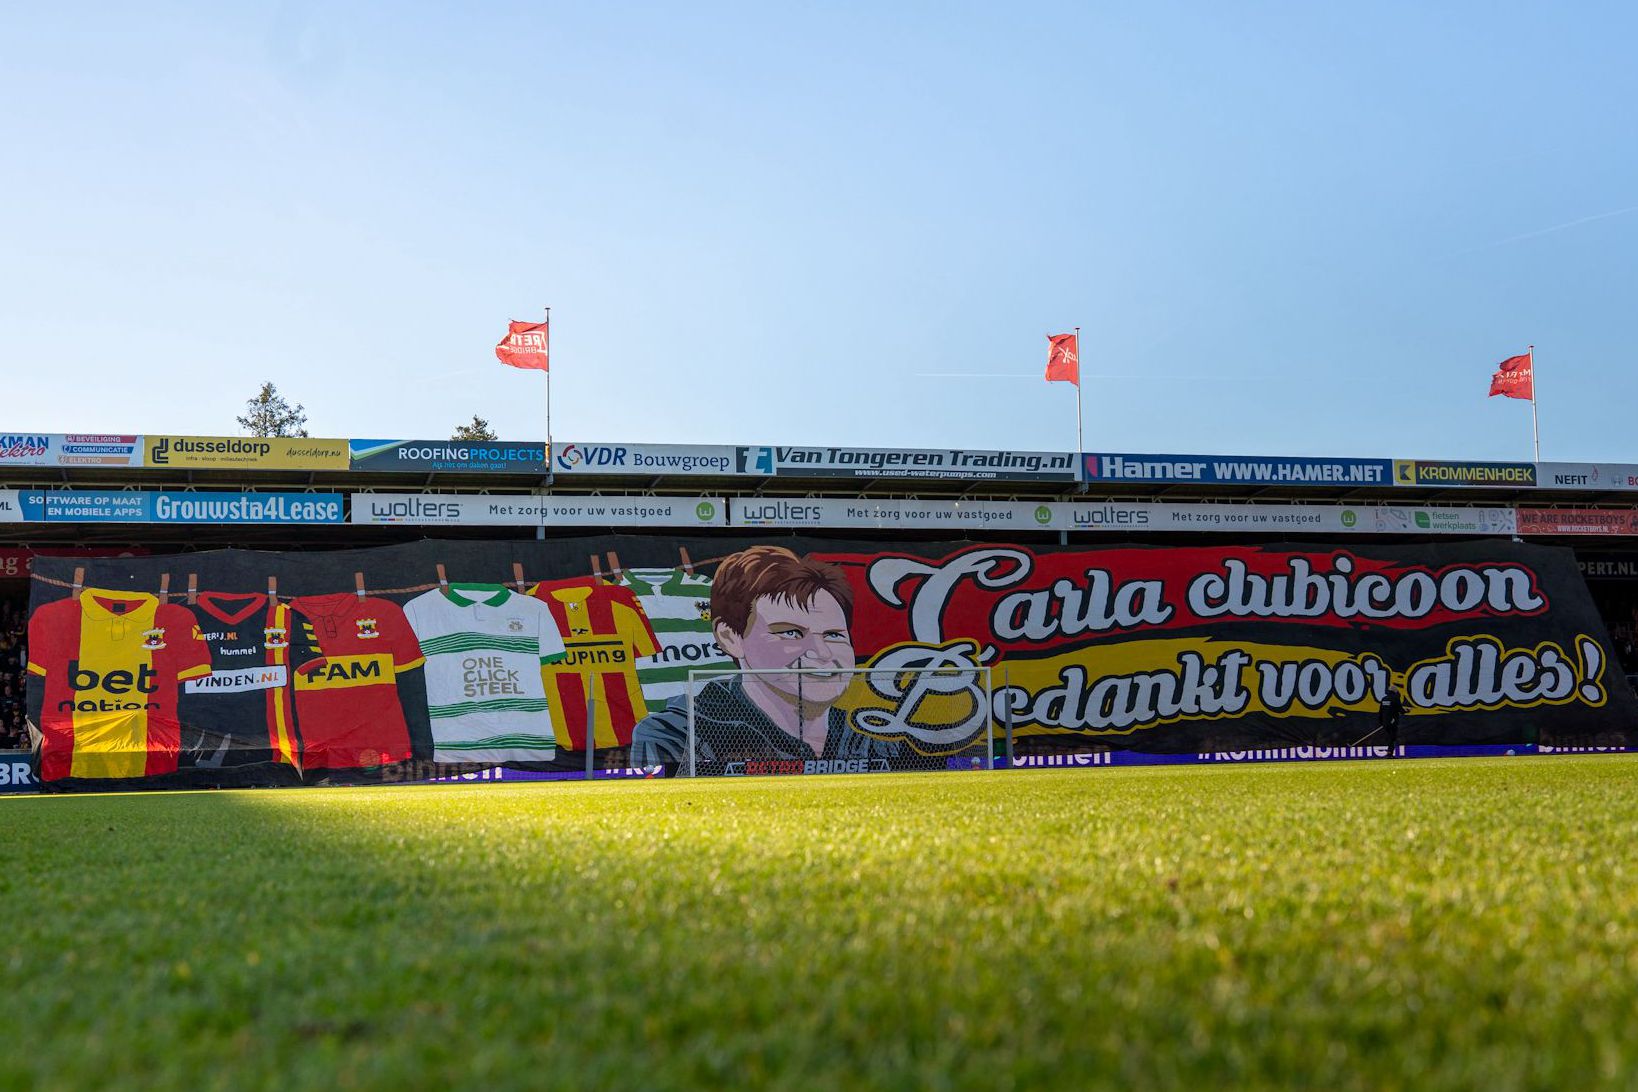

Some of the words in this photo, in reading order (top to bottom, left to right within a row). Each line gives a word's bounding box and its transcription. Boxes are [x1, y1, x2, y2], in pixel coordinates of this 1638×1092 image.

[174, 438, 270, 456] dusseldorp
[286, 447, 341, 458] dusseldorp.nu
[583, 447, 627, 466] VDR
[633, 453, 730, 472] Bouwgroep
[776, 447, 826, 464] Van
[827, 448, 944, 469] Tongeren
[949, 451, 1074, 472] Trading.nl
[854, 469, 997, 479] www.used-waterpumps.com
[1101, 456, 1207, 479] Hamer
[1213, 462, 1384, 482] WWW.HAMER.NET
[1419, 466, 1534, 482] KROMMENHOEK
[1554, 474, 1588, 485] NEFIT
[28, 496, 92, 504] SOFTWARE
[94, 496, 110, 505] OP
[112, 497, 143, 506] MAAT
[156, 495, 338, 521] Grouwsta4Lease
[372, 498, 461, 517] wolters
[48, 507, 62, 516] EN
[65, 507, 111, 516] MOBIELE
[114, 508, 143, 516] APPS
[489, 505, 513, 515] Met
[517, 505, 548, 518] zorg
[553, 507, 582, 516] voor
[587, 508, 605, 516] uw
[611, 506, 672, 518] vastgoed
[744, 501, 822, 520] wolters
[847, 508, 869, 518] Met
[873, 509, 900, 521] zorg
[905, 510, 930, 519] voor
[936, 510, 953, 519] uw
[957, 509, 1013, 521] vastgoed
[1073, 508, 1149, 524] wolters
[1172, 511, 1192, 521] Met
[1196, 512, 1221, 524] zorg
[1224, 513, 1248, 523] voor
[1252, 514, 1268, 523] uw
[1271, 512, 1322, 525] vastgoed
[1432, 512, 1460, 520] fietsen
[1432, 522, 1476, 531] werkplaats
[1521, 514, 1539, 524] WE
[1540, 514, 1560, 524] ARE
[1560, 513, 1626, 525] ROCKETBOYS
[1187, 556, 1544, 618] clubicoon
[220, 645, 257, 656] hummel
[462, 656, 504, 670] ONE
[67, 660, 159, 694] bet
[307, 660, 381, 684] FAM
[463, 668, 520, 684] CLICK
[463, 681, 525, 698] STEEL
[855, 643, 1249, 744] Bedankt
[1258, 658, 1391, 708] voor
[1409, 641, 1604, 708] alles!
[58, 698, 161, 714] nation
[0, 762, 40, 785] BR
